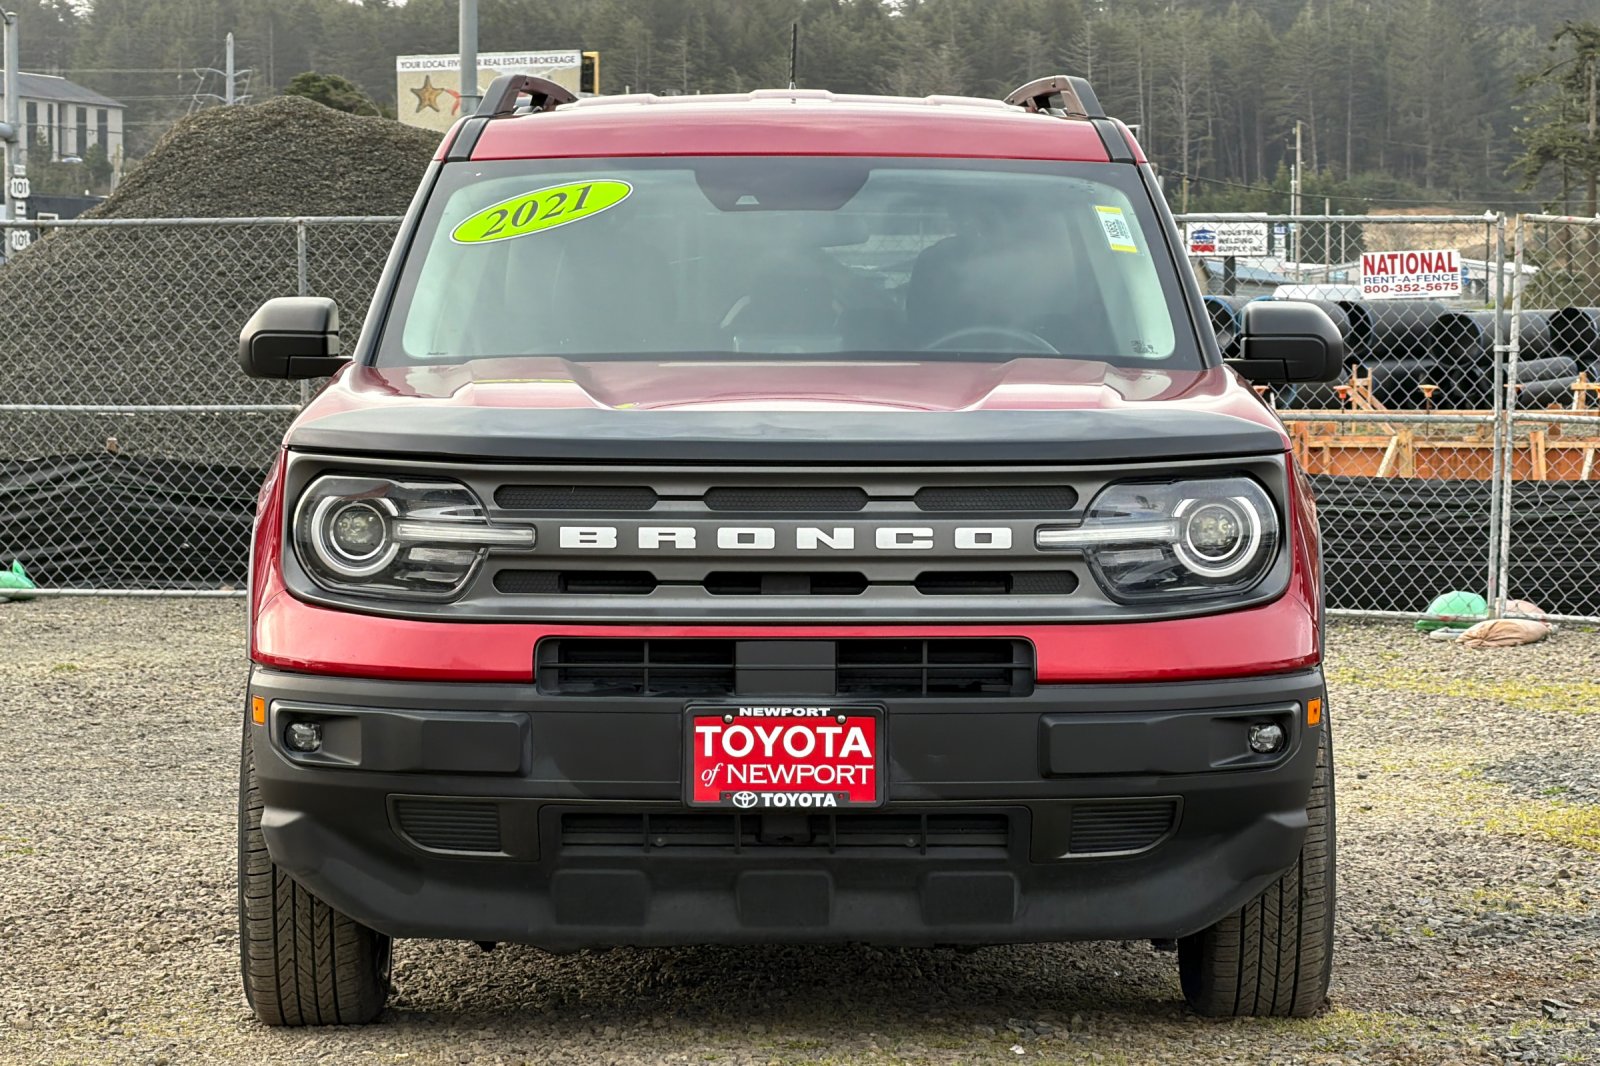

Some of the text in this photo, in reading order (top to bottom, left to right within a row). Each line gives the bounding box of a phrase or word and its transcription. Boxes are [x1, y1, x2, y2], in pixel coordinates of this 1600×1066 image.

[401, 61, 421, 69] YOUR
[422, 60, 446, 69] LOCAL
[448, 59, 461, 68] FIV
[483, 58, 501, 66] REAL
[503, 57, 527, 65] ESTATE
[529, 55, 576, 64] BROKERAGE
[13, 181, 27, 194] 101
[480, 184, 592, 238] 2021
[14, 234, 28, 246] 101
[1363, 252, 1458, 276] NATIONAL
[1363, 273, 1459, 285] RENT-A-FENCE
[1364, 282, 1459, 294] 800-352-5675
[560, 526, 1013, 550] BRONCO
[739, 707, 830, 717] NEWPORT
[695, 725, 872, 758] TOYOTA
[701, 762, 874, 787] of NEWPORT
[761, 792, 837, 807] TOYOTA
